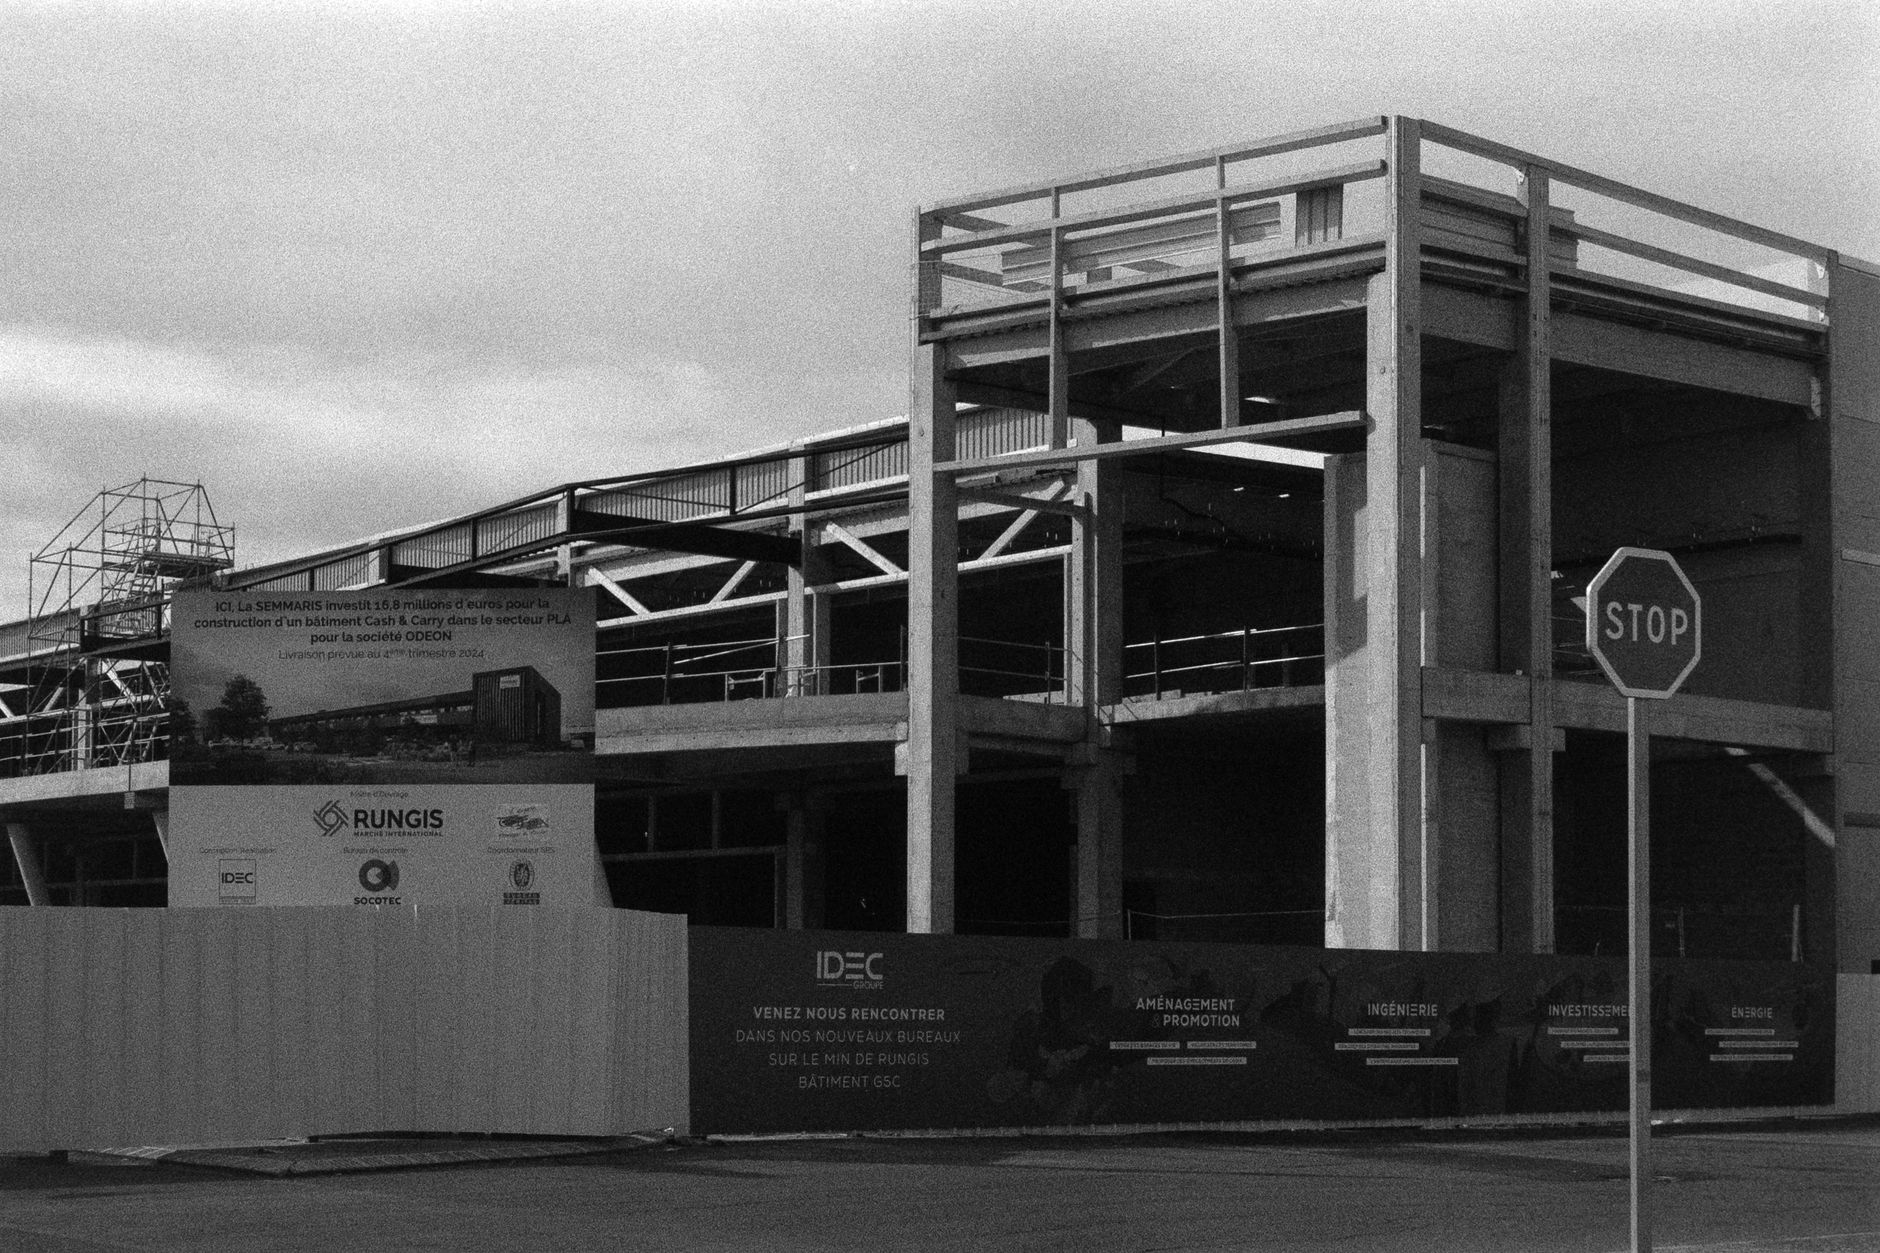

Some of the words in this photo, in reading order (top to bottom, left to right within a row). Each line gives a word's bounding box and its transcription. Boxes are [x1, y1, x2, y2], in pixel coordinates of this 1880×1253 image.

[215, 601, 235, 613] ICI,
[238, 601, 253, 612] La
[255, 600, 323, 612] SEMMARIS
[325, 600, 371, 611] investit
[374, 600, 400, 613] 16,8
[403, 599, 452, 610] millions
[506, 599, 535, 612] pour
[538, 598, 550, 609] la
[194, 616, 272, 628] construction
[275, 616, 302, 628] d'un
[305, 615, 362, 627] bâtiment
[364, 615, 396, 627] Cash
[399, 615, 408, 626] &
[410, 615, 445, 629] Carry
[447, 614, 477, 626] dans
[480, 614, 493, 625] le
[496, 614, 544, 625] secteur
[547, 613, 572, 625] PLA
[1605, 601, 1688, 645] STOP
[310, 633, 339, 645] pour
[342, 632, 354, 642] la
[356, 630, 402, 642] société
[405, 630, 453, 641] ODEON
[278, 649, 325, 660] Livraison
[367, 651, 381, 659] au
[408, 648, 456, 658] trimestre
[459, 648, 485, 658] 2024
[354, 809, 443, 829] RUNGIS
[221, 872, 254, 884] IDEC
[353, 897, 402, 905] SOCOTEC
[816, 950, 884, 980] IDEC
[853, 981, 884, 990] GROUPE
[1135, 995, 1236, 1011] AMÉNAGEMENT
[1367, 1000, 1438, 1017] INGÉNIERIE
[1548, 1004, 1630, 1017] INVESTISSEME
[753, 1006, 801, 1020] VENEZ
[806, 1007, 847, 1020] NOUS
[851, 1007, 945, 1021] RENCONTRER
[1731, 1004, 1773, 1018] ÉNERGIE
[1163, 1014, 1240, 1027] PROMOTION
[736, 1029, 776, 1043] DANS
[781, 1029, 811, 1043] NOS
[815, 1030, 893, 1043] NOUVEAUX
[897, 1030, 961, 1043] BUREAUX
[768, 1053, 798, 1066] SUR
[802, 1053, 819, 1066] LE
[824, 1053, 850, 1065] MIN
[855, 1053, 874, 1066] DE
[878, 1053, 930, 1065] RUNGIS
[798, 1073, 869, 1089] BÂTIMENT
[873, 1075, 901, 1088] G5C
